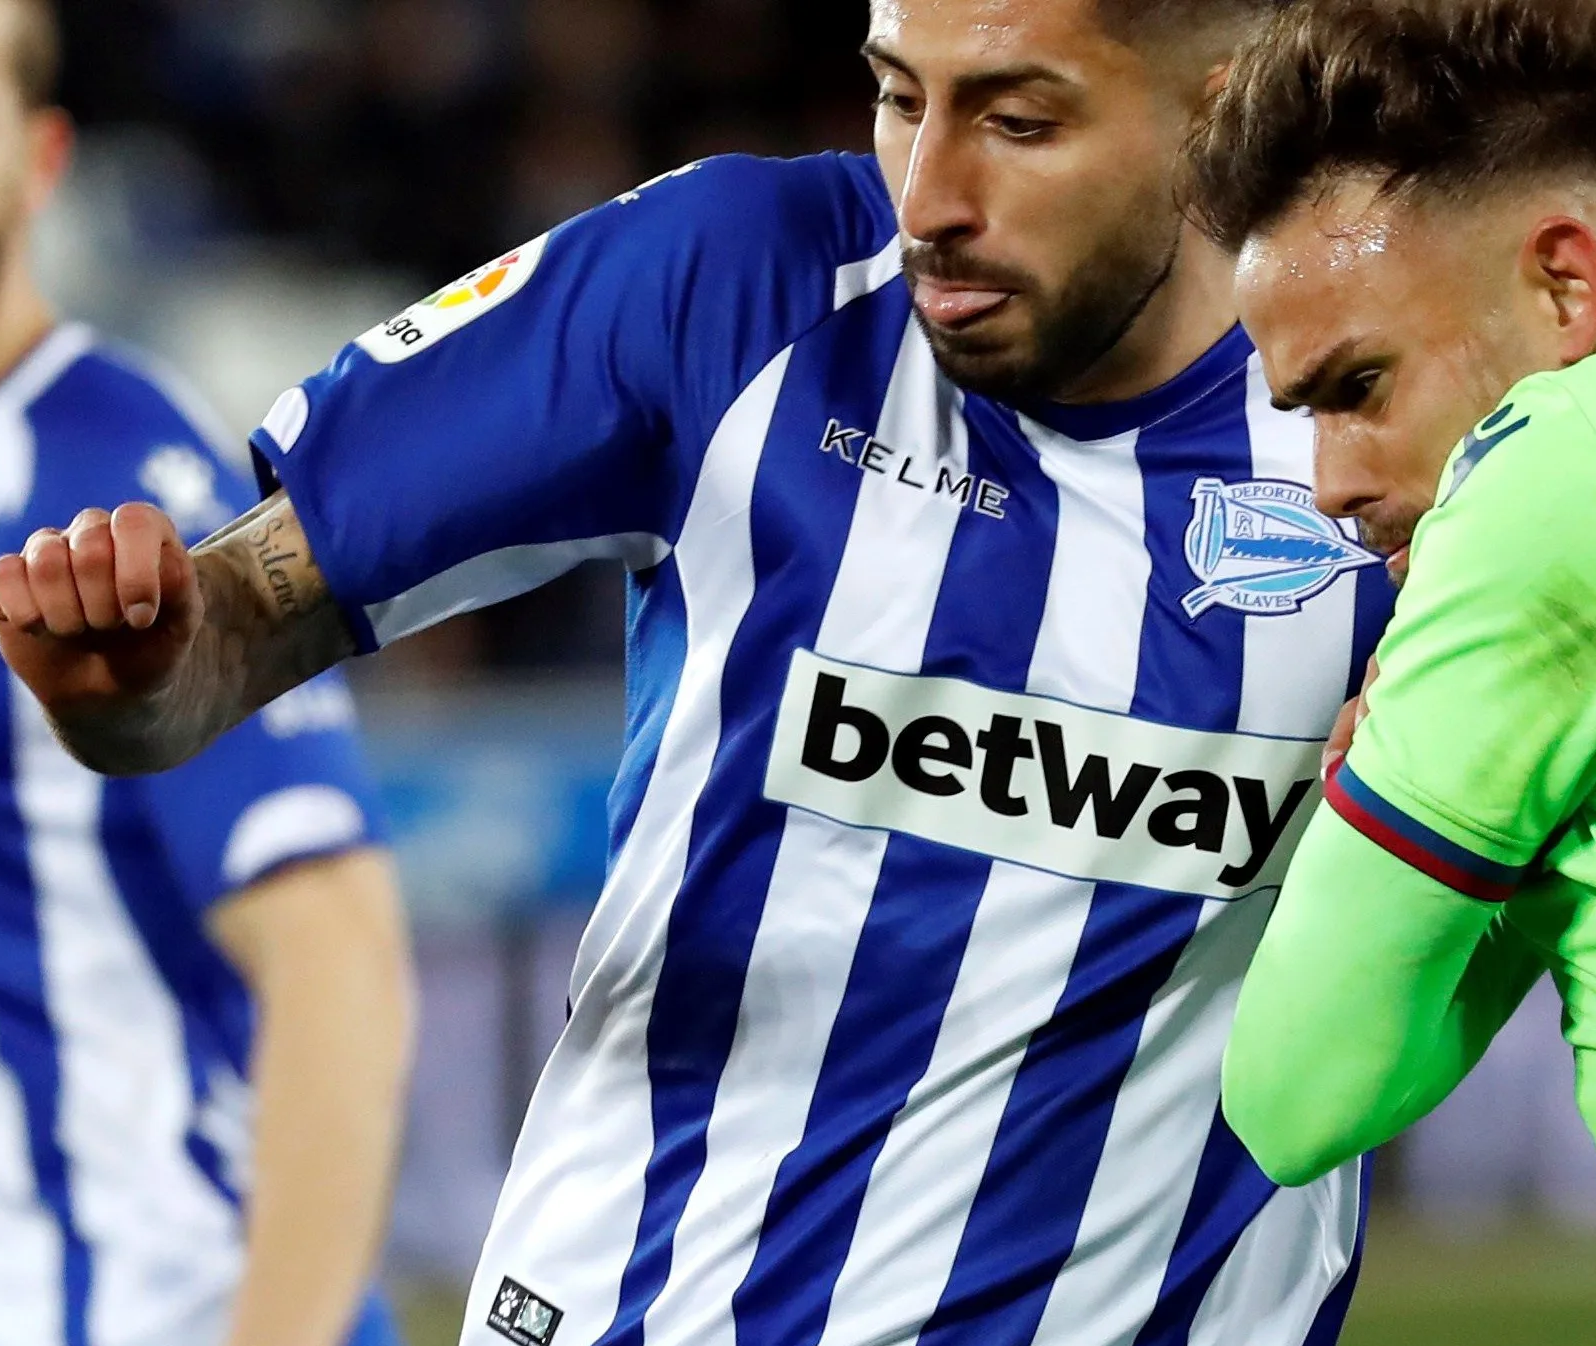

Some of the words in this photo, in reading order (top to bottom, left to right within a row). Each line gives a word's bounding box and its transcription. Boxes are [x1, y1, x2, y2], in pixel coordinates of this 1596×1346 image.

[819, 418, 1010, 520] KELME
[1230, 592, 1294, 609] ALAVES
[800, 671, 1315, 888] betway
